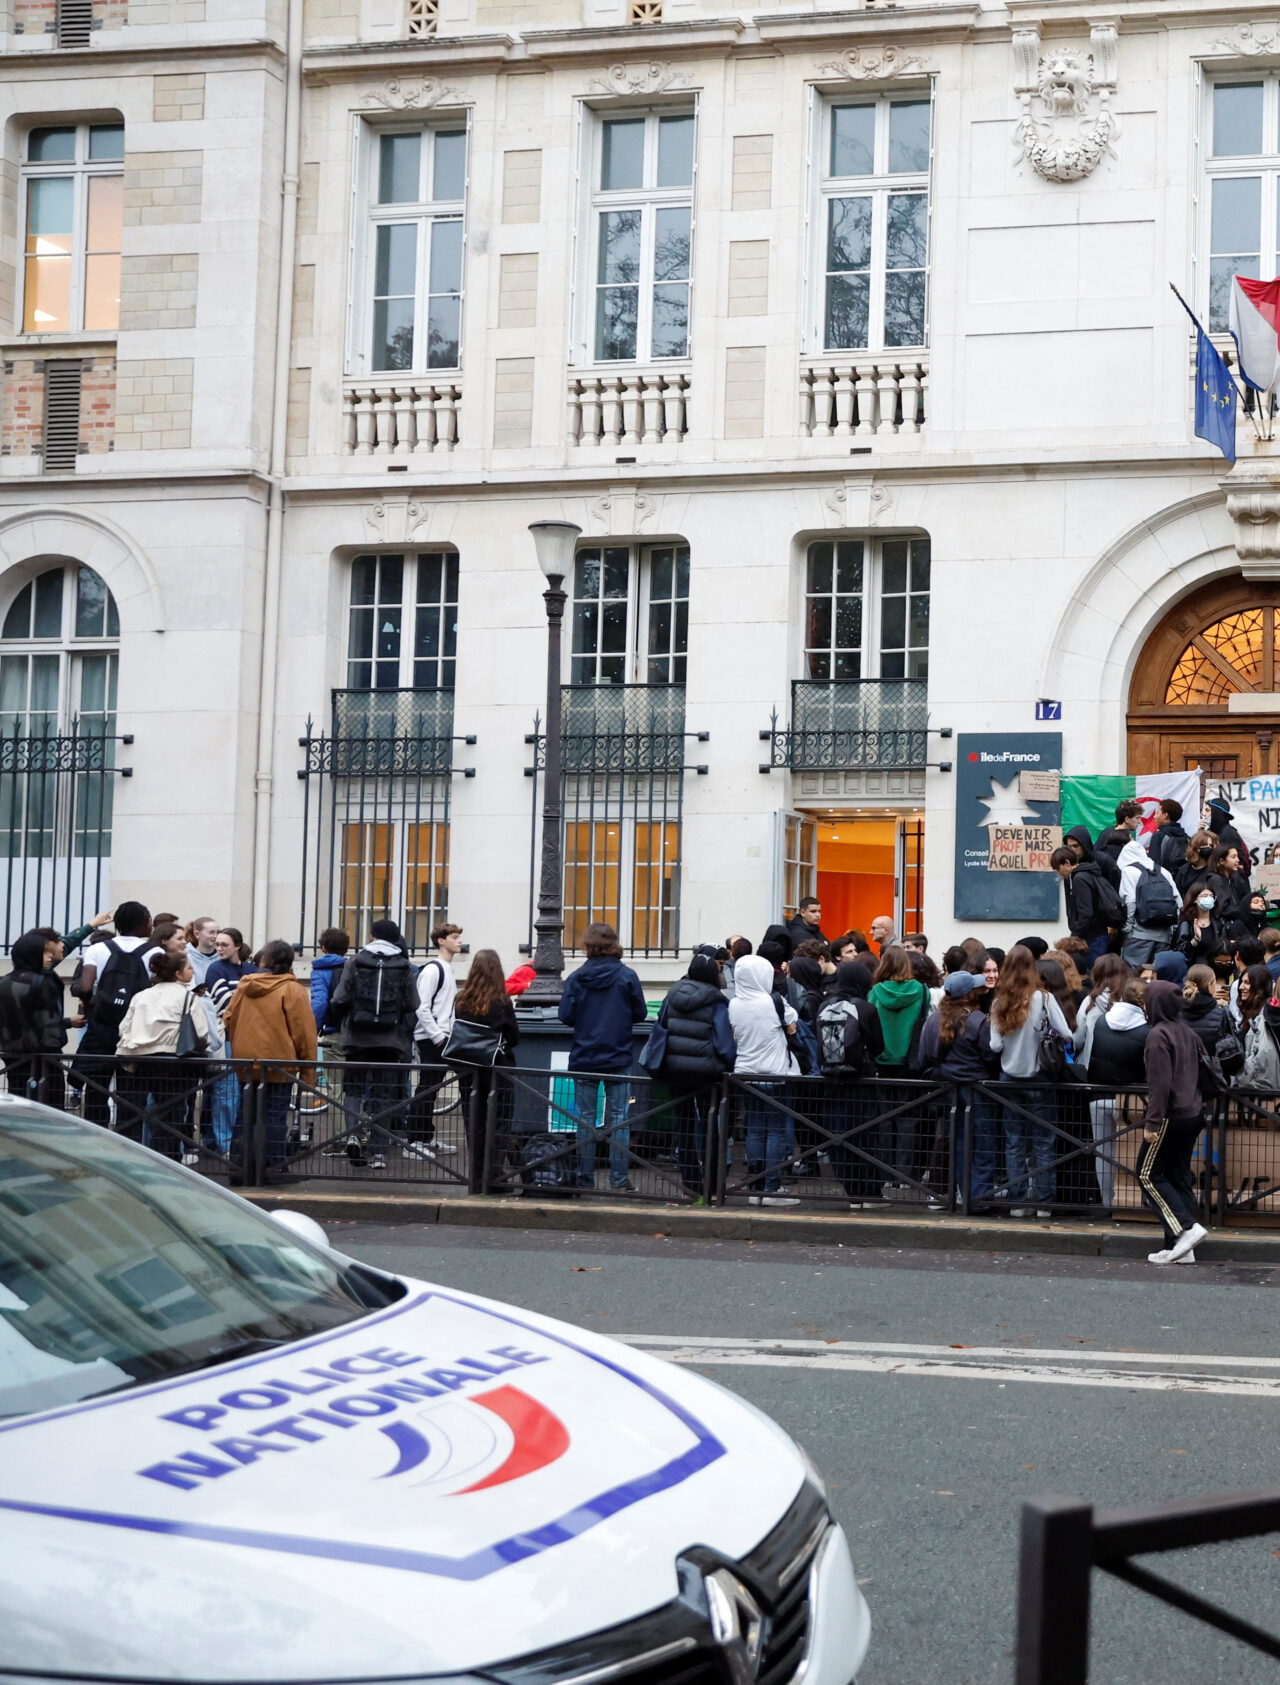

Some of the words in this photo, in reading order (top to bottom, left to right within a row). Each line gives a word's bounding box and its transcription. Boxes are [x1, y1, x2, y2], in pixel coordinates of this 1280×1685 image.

[1038, 703, 1058, 719] 17
[1218, 781, 1247, 802] NI
[995, 828, 1051, 840] DEVENIR
[993, 840, 1023, 853] PROF
[1025, 840, 1053, 852] MAIS
[1029, 852, 1053, 869] PRI
[158, 1346, 427, 1431] POLICE
[135, 1346, 551, 1491] NATIONALE
